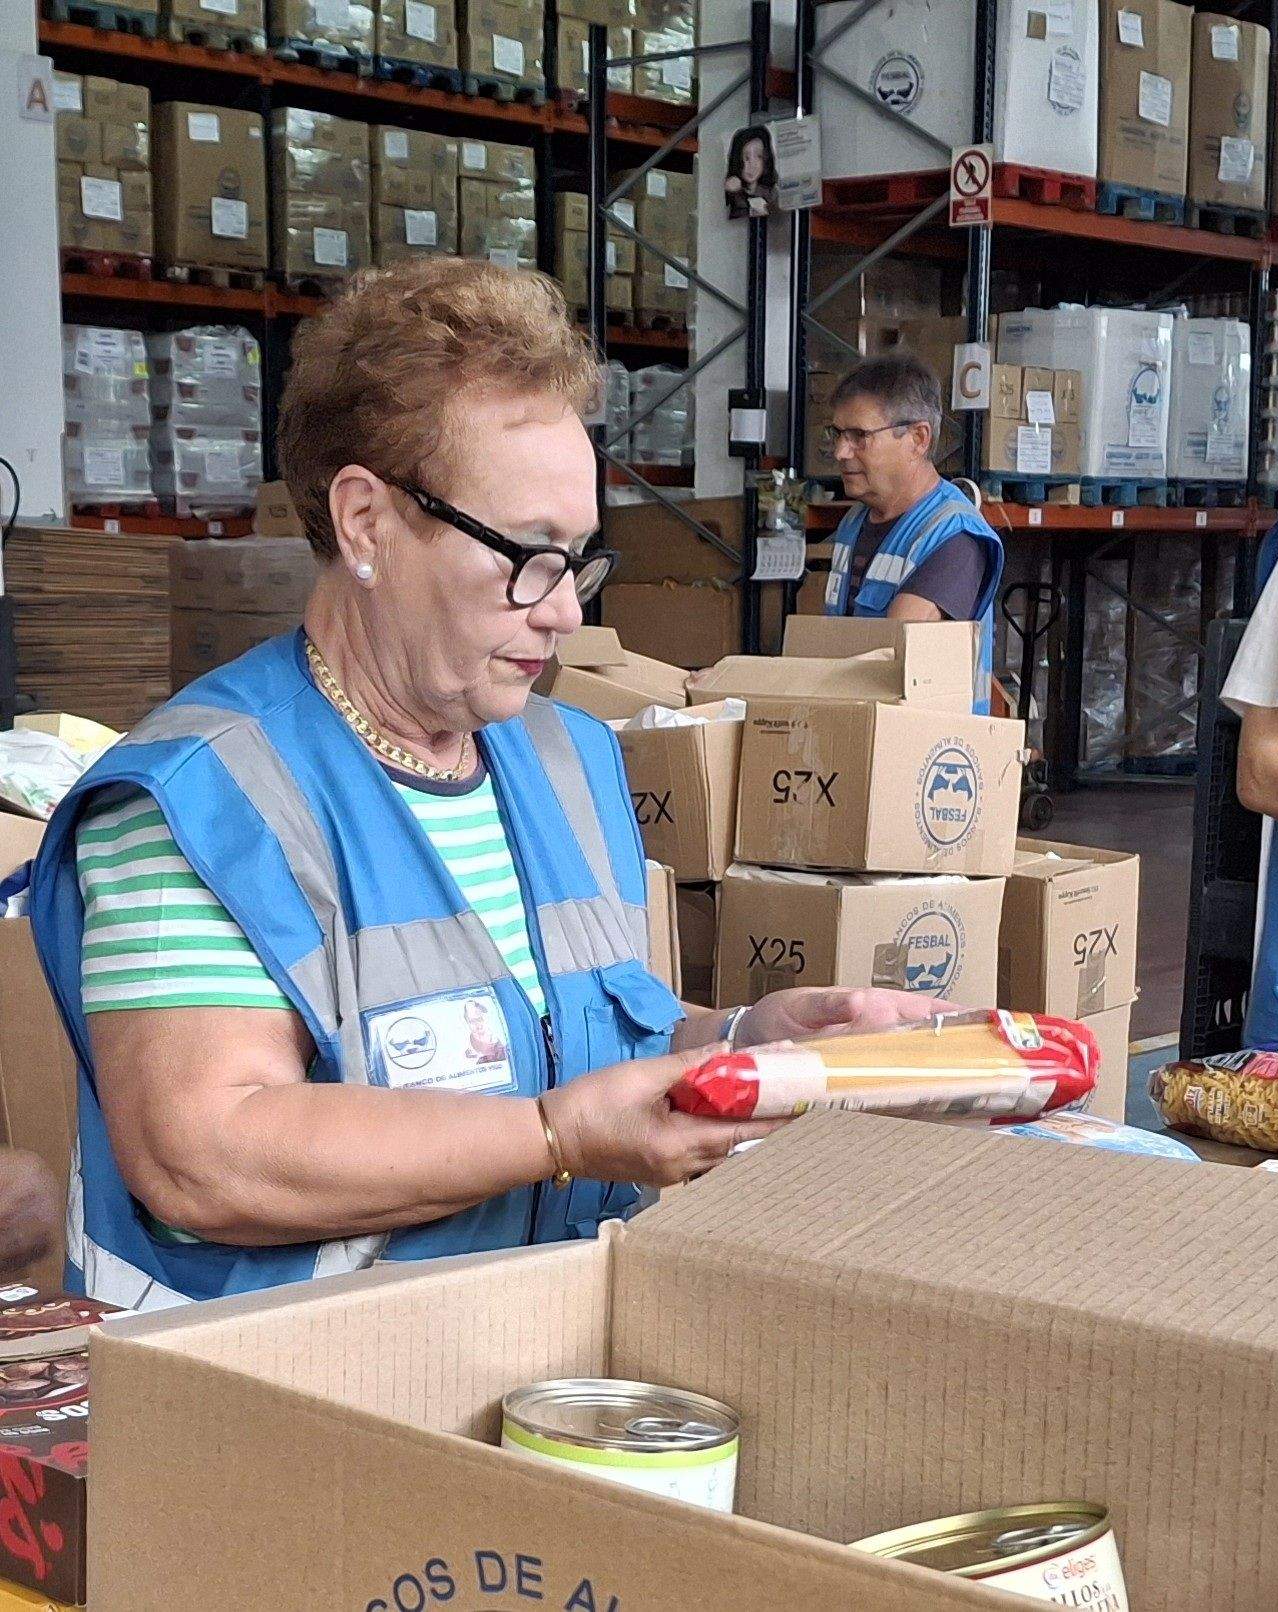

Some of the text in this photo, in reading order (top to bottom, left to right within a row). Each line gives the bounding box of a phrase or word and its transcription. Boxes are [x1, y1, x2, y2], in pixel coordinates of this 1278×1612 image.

[26, 78, 49, 111] A
[960, 360, 982, 399] C
[631, 790, 675, 826] X2
[773, 769, 840, 808] X25
[930, 806, 967, 822] FESBAL
[746, 934, 806, 975] X25
[907, 934, 951, 950] FESBAL
[1073, 923, 1119, 967] X25
[475, 1550, 544, 1600] DE
